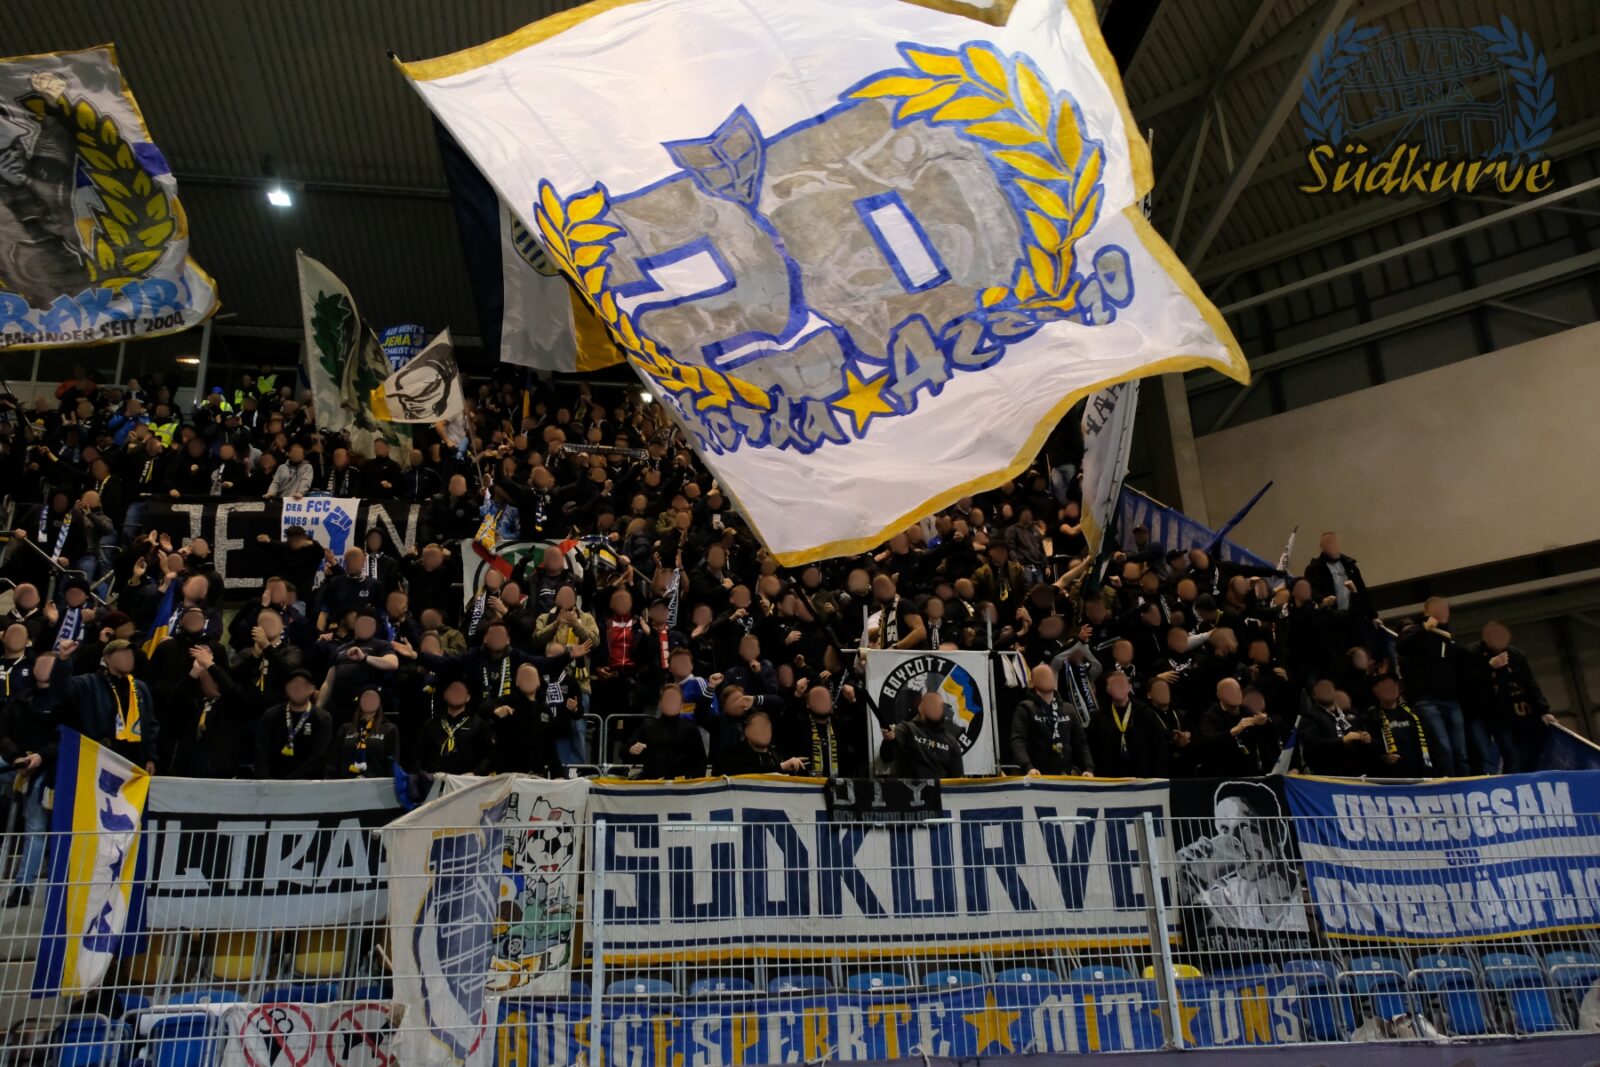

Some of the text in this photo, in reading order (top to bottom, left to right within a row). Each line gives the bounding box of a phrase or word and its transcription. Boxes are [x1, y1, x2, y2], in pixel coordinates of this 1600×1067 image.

[101, 320, 137, 339] SEIT
[143, 311, 187, 334] 2004
[380, 334, 411, 347] JENA
[283, 515, 320, 526] MUSS IN
[285, 500, 331, 513] DER FCC
[883, 657, 946, 699] BOYCOTT
[1332, 781, 1578, 843] UNBEUGSAM
[148, 817, 388, 891] LTRA
[592, 806, 1174, 926] SÜDKURVE
[1445, 849, 1480, 867] UND
[1032, 992, 1142, 1054] MIT
[1209, 984, 1301, 1044] UNS
